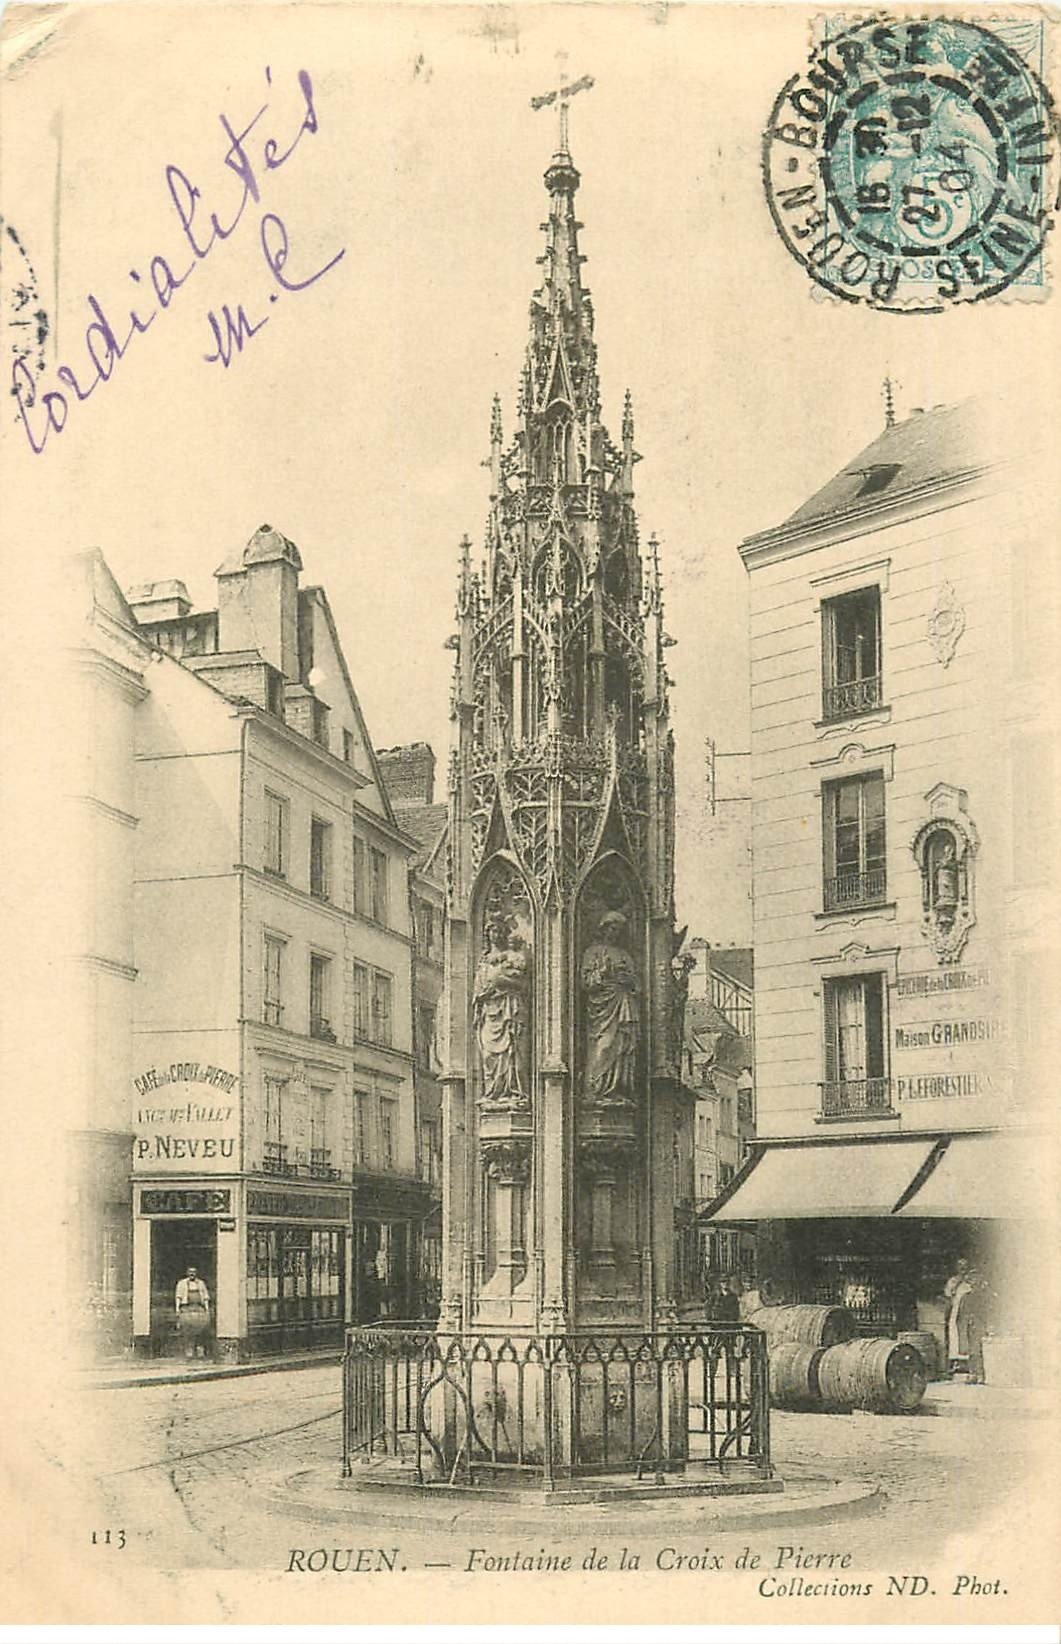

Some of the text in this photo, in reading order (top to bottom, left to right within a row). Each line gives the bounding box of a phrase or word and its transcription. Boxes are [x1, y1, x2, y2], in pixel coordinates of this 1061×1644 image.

[12, 65, 319, 454] Cordialités
[895, 1027, 930, 1049] Maison
[170, 1063, 200, 1083] CROIX
[205, 1065, 239, 1095] PIERRE
